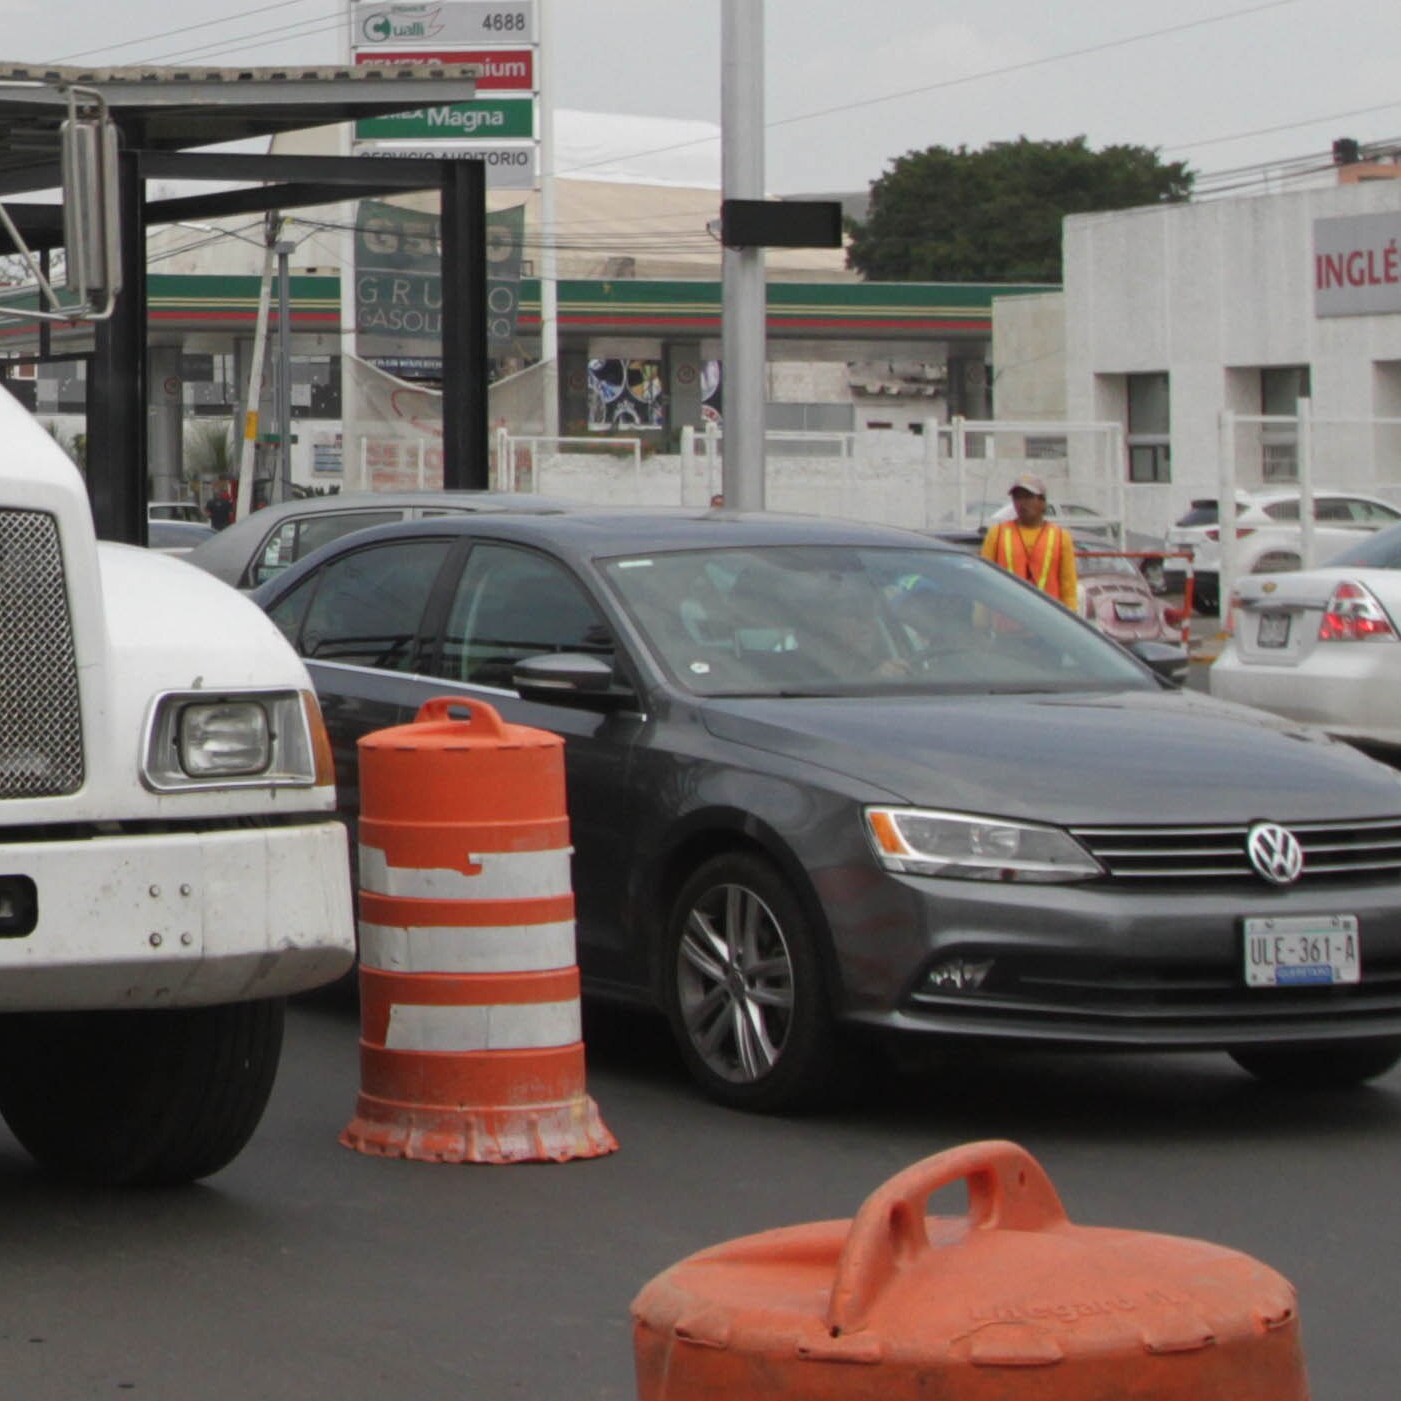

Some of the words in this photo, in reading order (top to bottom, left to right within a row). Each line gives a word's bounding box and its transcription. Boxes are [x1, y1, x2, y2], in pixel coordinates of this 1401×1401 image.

[482, 13, 525, 32] 4688
[427, 107, 504, 132] Magna
[1316, 238, 1399, 290] INGLÉ
[357, 275, 514, 314] GRUO
[357, 307, 512, 338] GASOLIO
[1251, 934, 1355, 965] ULE-361-A
